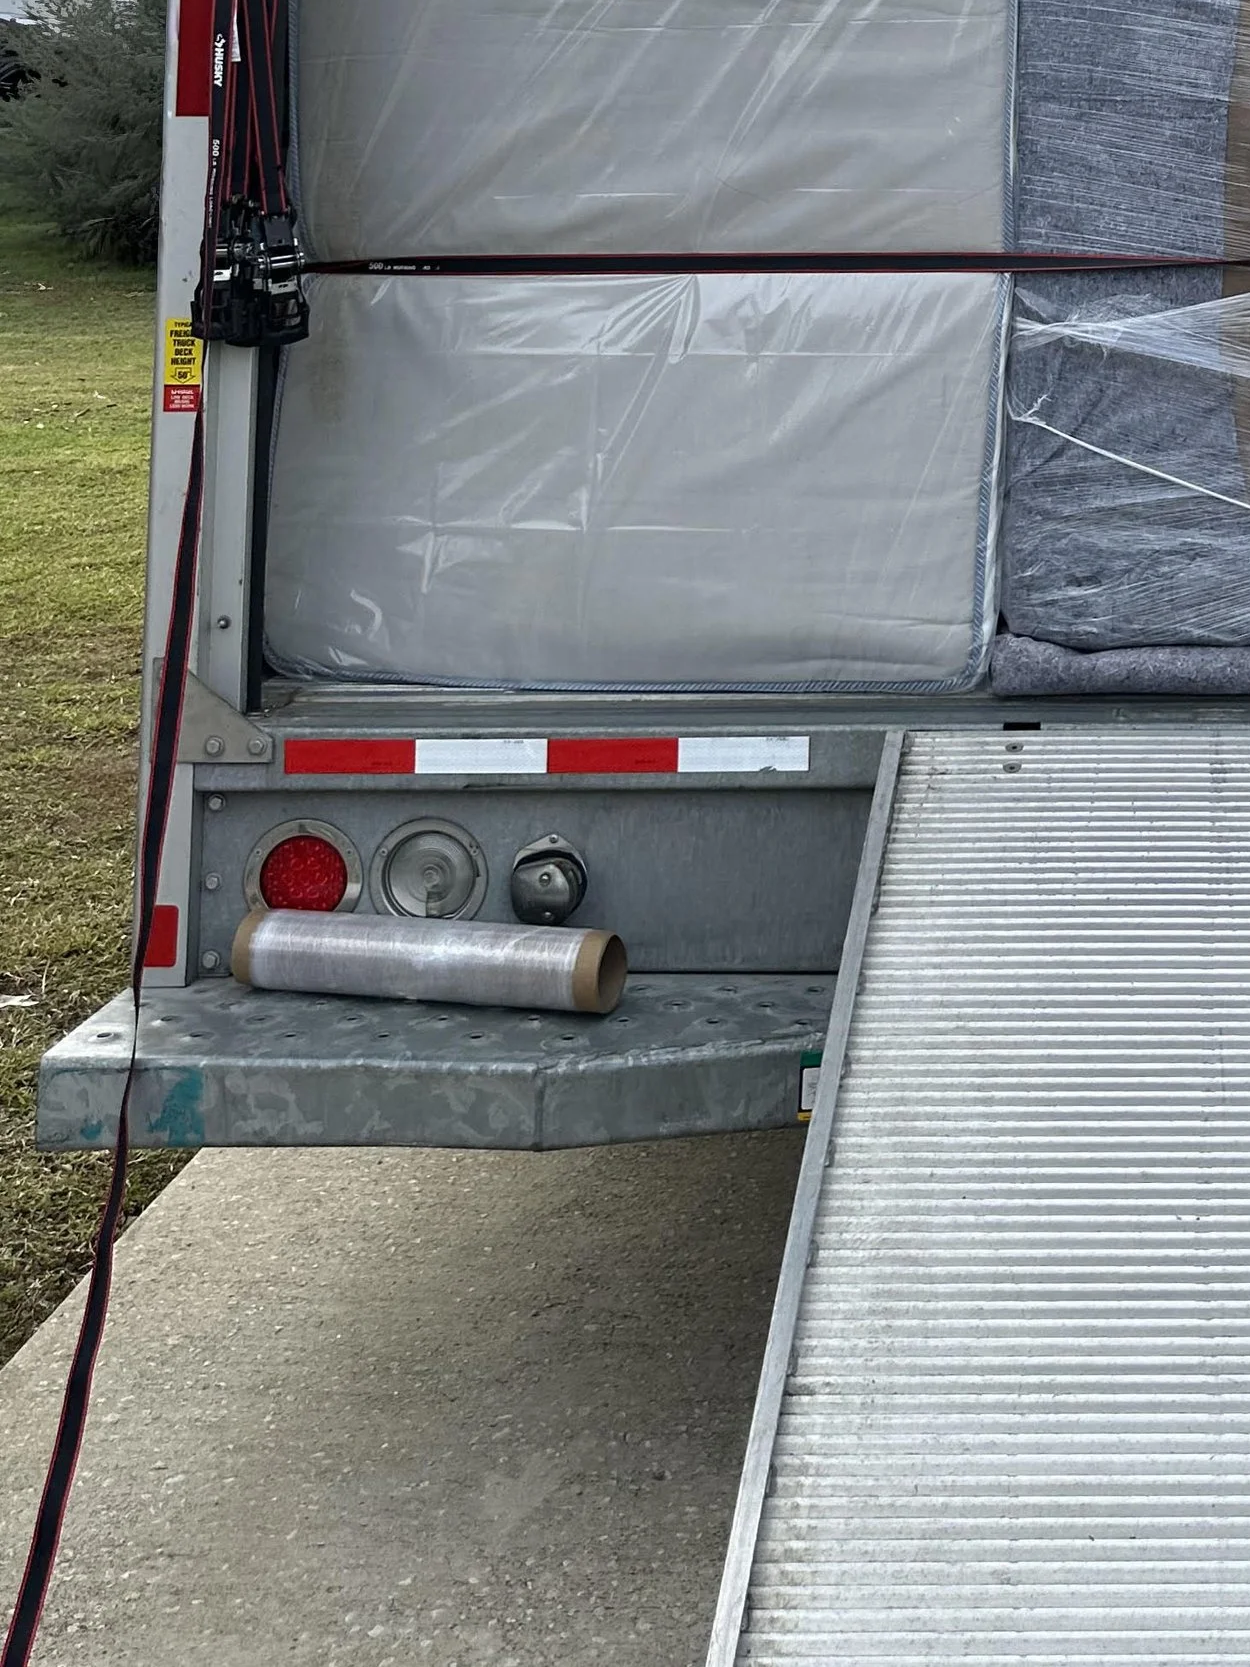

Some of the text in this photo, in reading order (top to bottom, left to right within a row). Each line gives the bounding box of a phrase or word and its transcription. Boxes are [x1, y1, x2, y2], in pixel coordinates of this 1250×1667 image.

[213, 47, 225, 87] HUSKY
[212, 139, 221, 157] 500
[173, 339, 196, 347] TRUCK
[174, 348, 194, 356] DECK
[171, 357, 197, 366] HEIGHT
